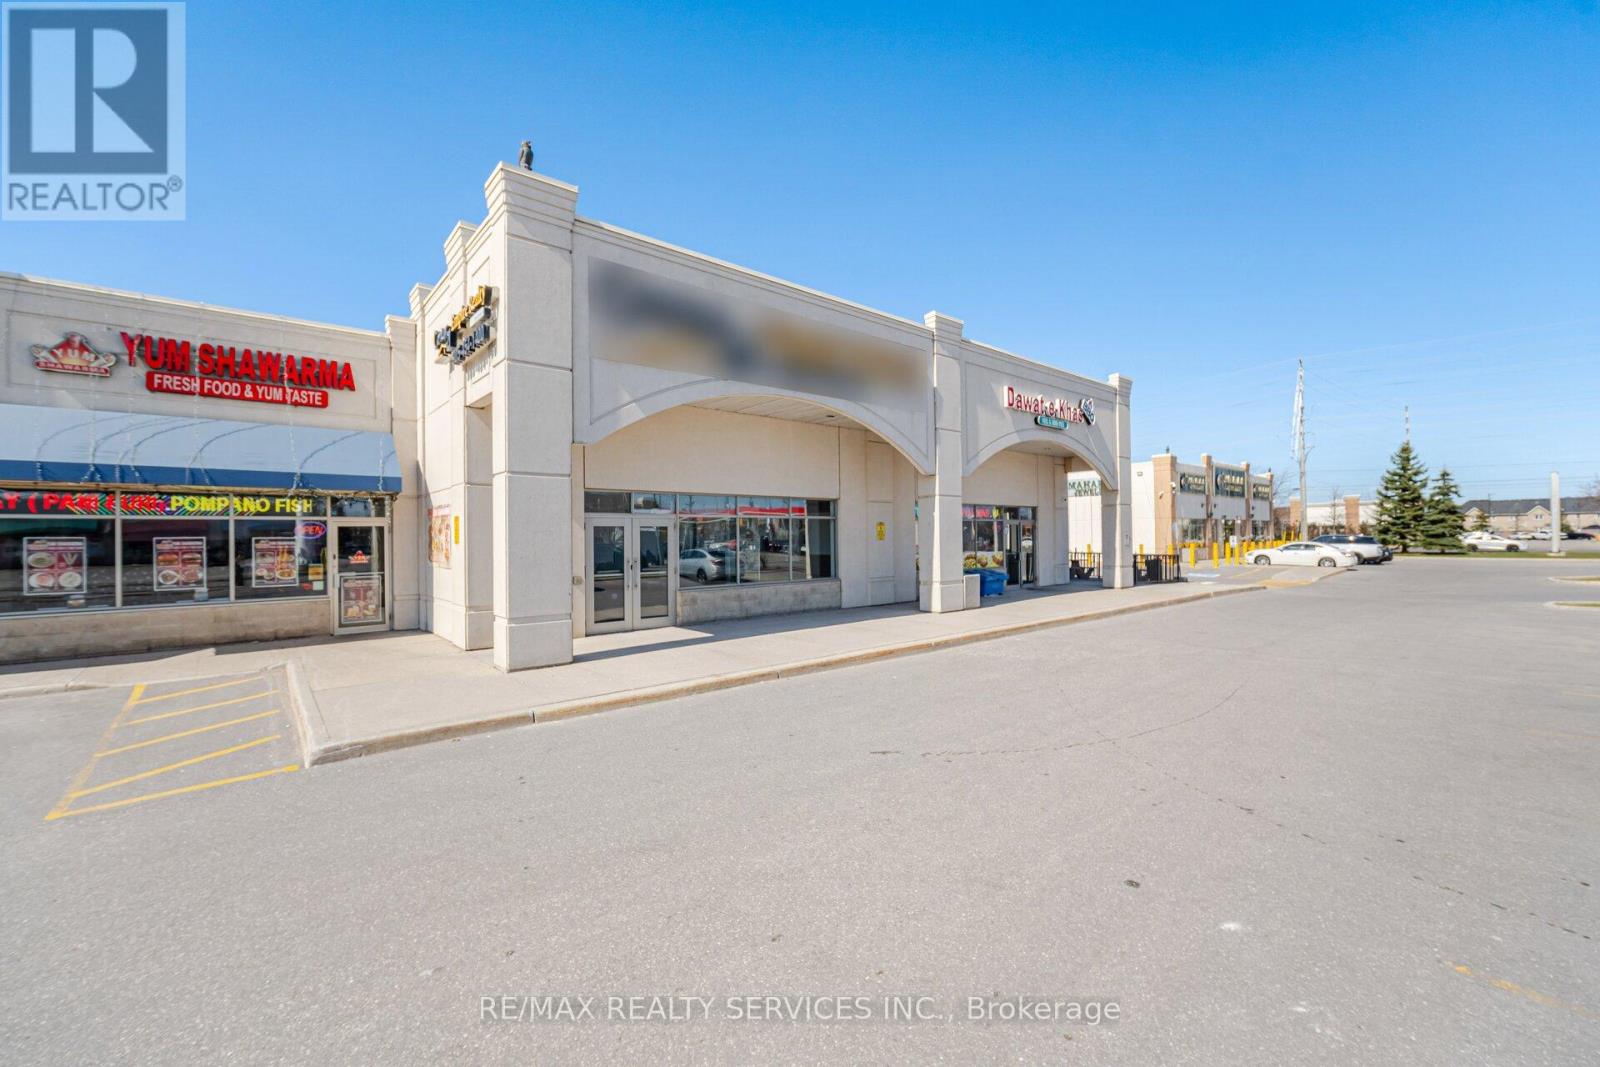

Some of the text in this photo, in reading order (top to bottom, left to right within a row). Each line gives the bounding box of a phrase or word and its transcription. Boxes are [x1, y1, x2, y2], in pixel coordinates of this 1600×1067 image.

[51, 348, 97, 362] YUM
[119, 331, 356, 391] YUM SHAWARMA
[153, 373, 323, 406] FRESH FOOD & YUM TASTE
[170, 495, 271, 513] POMPANO
[275, 497, 313, 513] FISH
